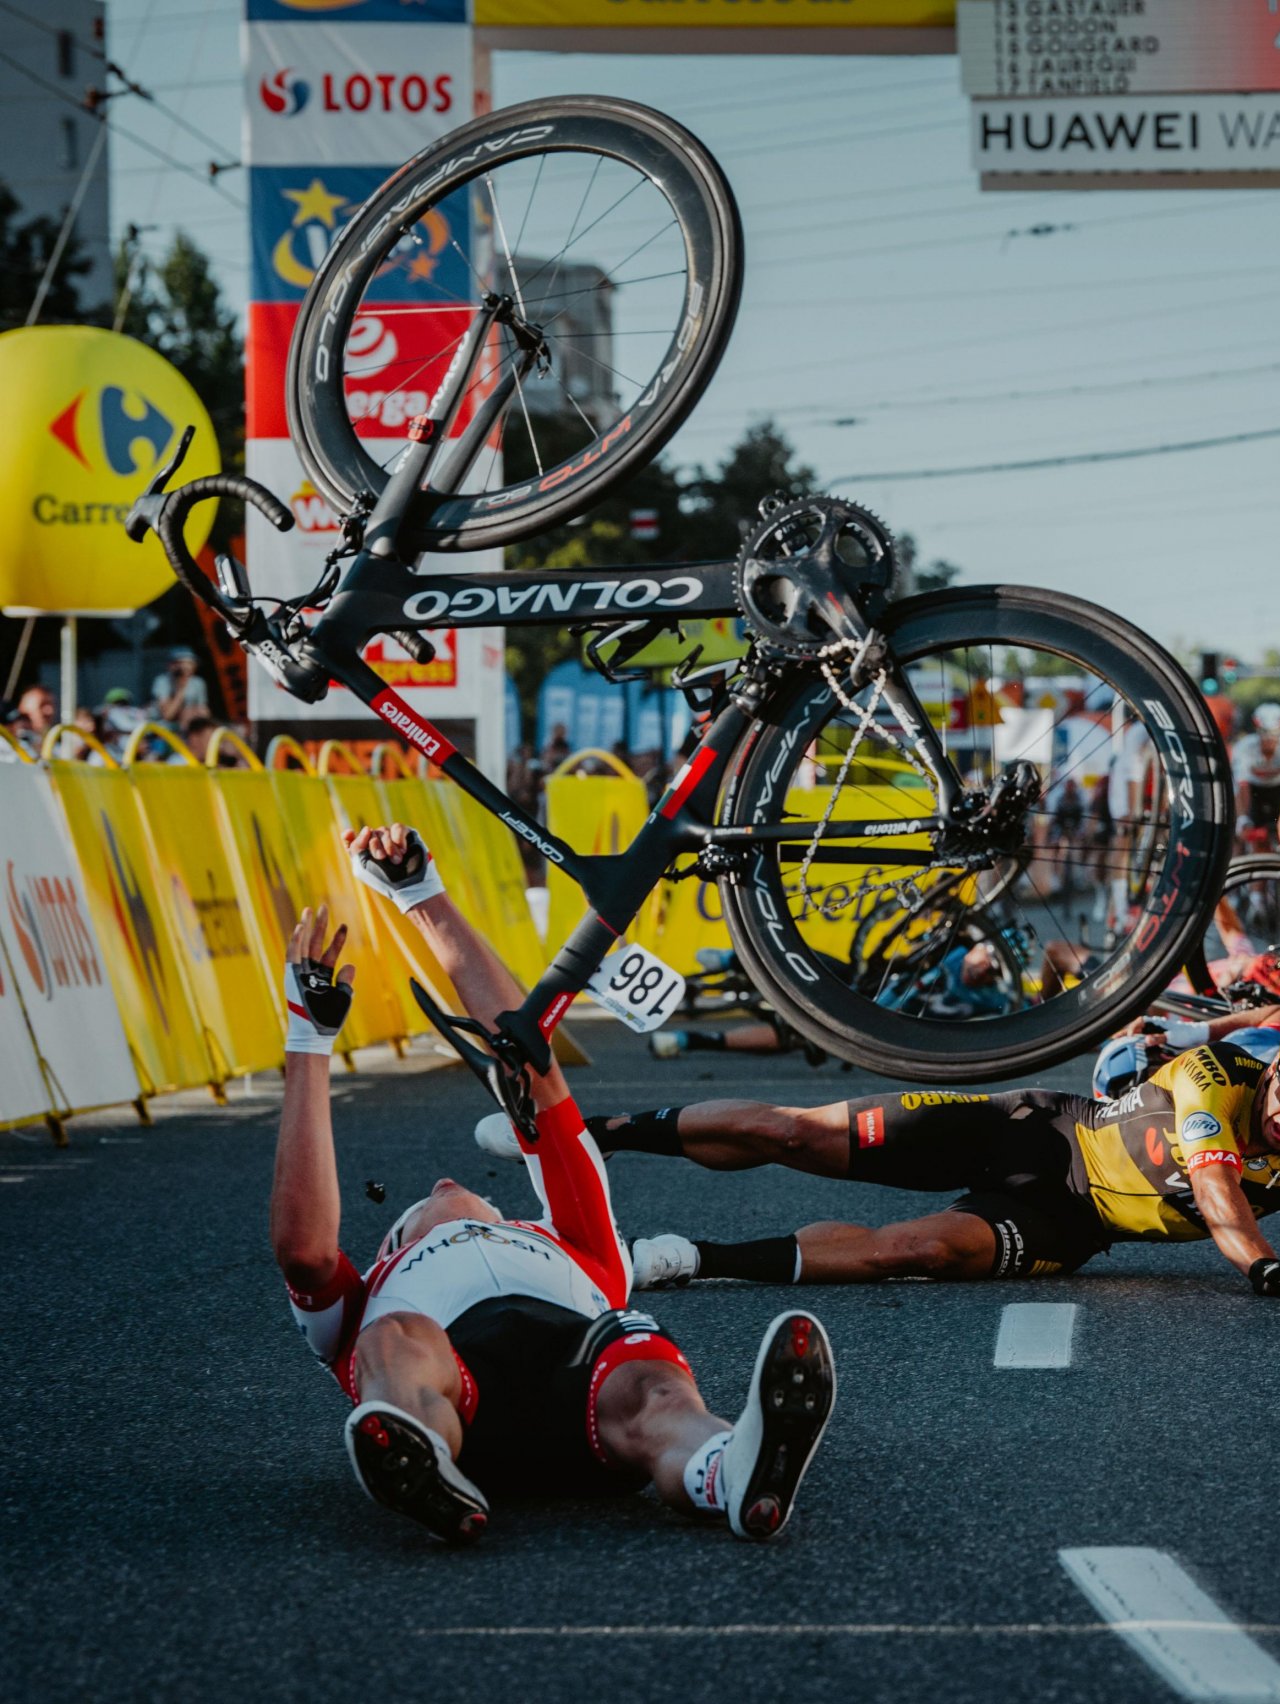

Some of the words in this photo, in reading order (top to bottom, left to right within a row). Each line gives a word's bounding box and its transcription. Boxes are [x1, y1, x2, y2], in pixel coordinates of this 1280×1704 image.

[1026, 19, 1117, 34] GODON
[322, 73, 453, 113] LOTOS
[980, 111, 1200, 153] HUAWEI
[345, 390, 429, 427] erga
[33, 493, 135, 526] Carre
[402, 576, 704, 622] COLNAGO
[378, 700, 441, 758] Emirates
[1143, 699, 1195, 830] BORA
[499, 810, 566, 866] CONCEPT
[609, 953, 679, 1017] 186
[543, 994, 569, 1028] COLNAGO
[1182, 1057, 1212, 1093] VISMA
[1194, 1049, 1227, 1087] MBO
[1234, 1056, 1264, 1071] JUMBO
[864, 1111, 876, 1144] HEMA
[1187, 1150, 1238, 1171] HEMA
